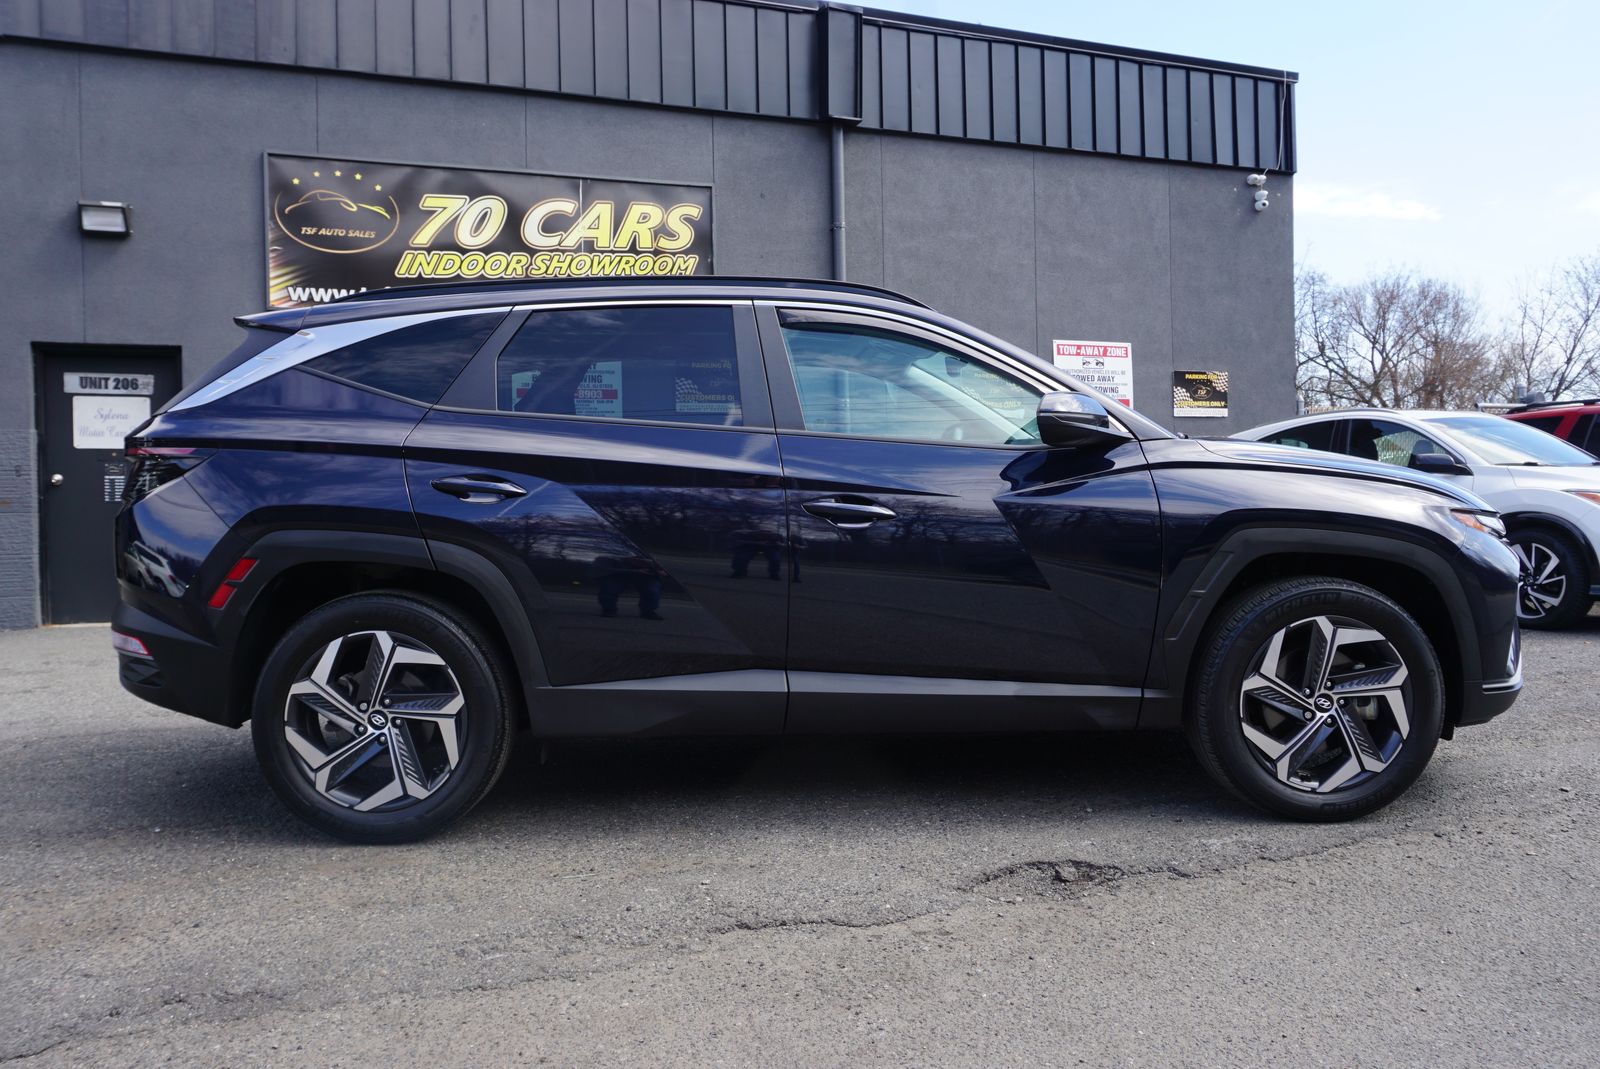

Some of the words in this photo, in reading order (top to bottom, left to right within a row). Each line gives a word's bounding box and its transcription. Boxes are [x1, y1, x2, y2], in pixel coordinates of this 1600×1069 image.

[409, 194, 508, 249] 70
[520, 198, 703, 251] CARS
[301, 226, 318, 236] TSF
[319, 227, 346, 237] AUTO
[348, 229, 376, 239] SALES
[395, 250, 531, 278] INDOOR
[529, 252, 699, 276] SHOWROOM
[1058, 345, 1105, 356] TOW-AWAY
[1106, 346, 1127, 357] ZONE
[79, 376, 110, 390] UNIT
[112, 377, 139, 391] 206
[1094, 385, 1119, 394] TOWING
[1264, 591, 1341, 622] MICHELIN
